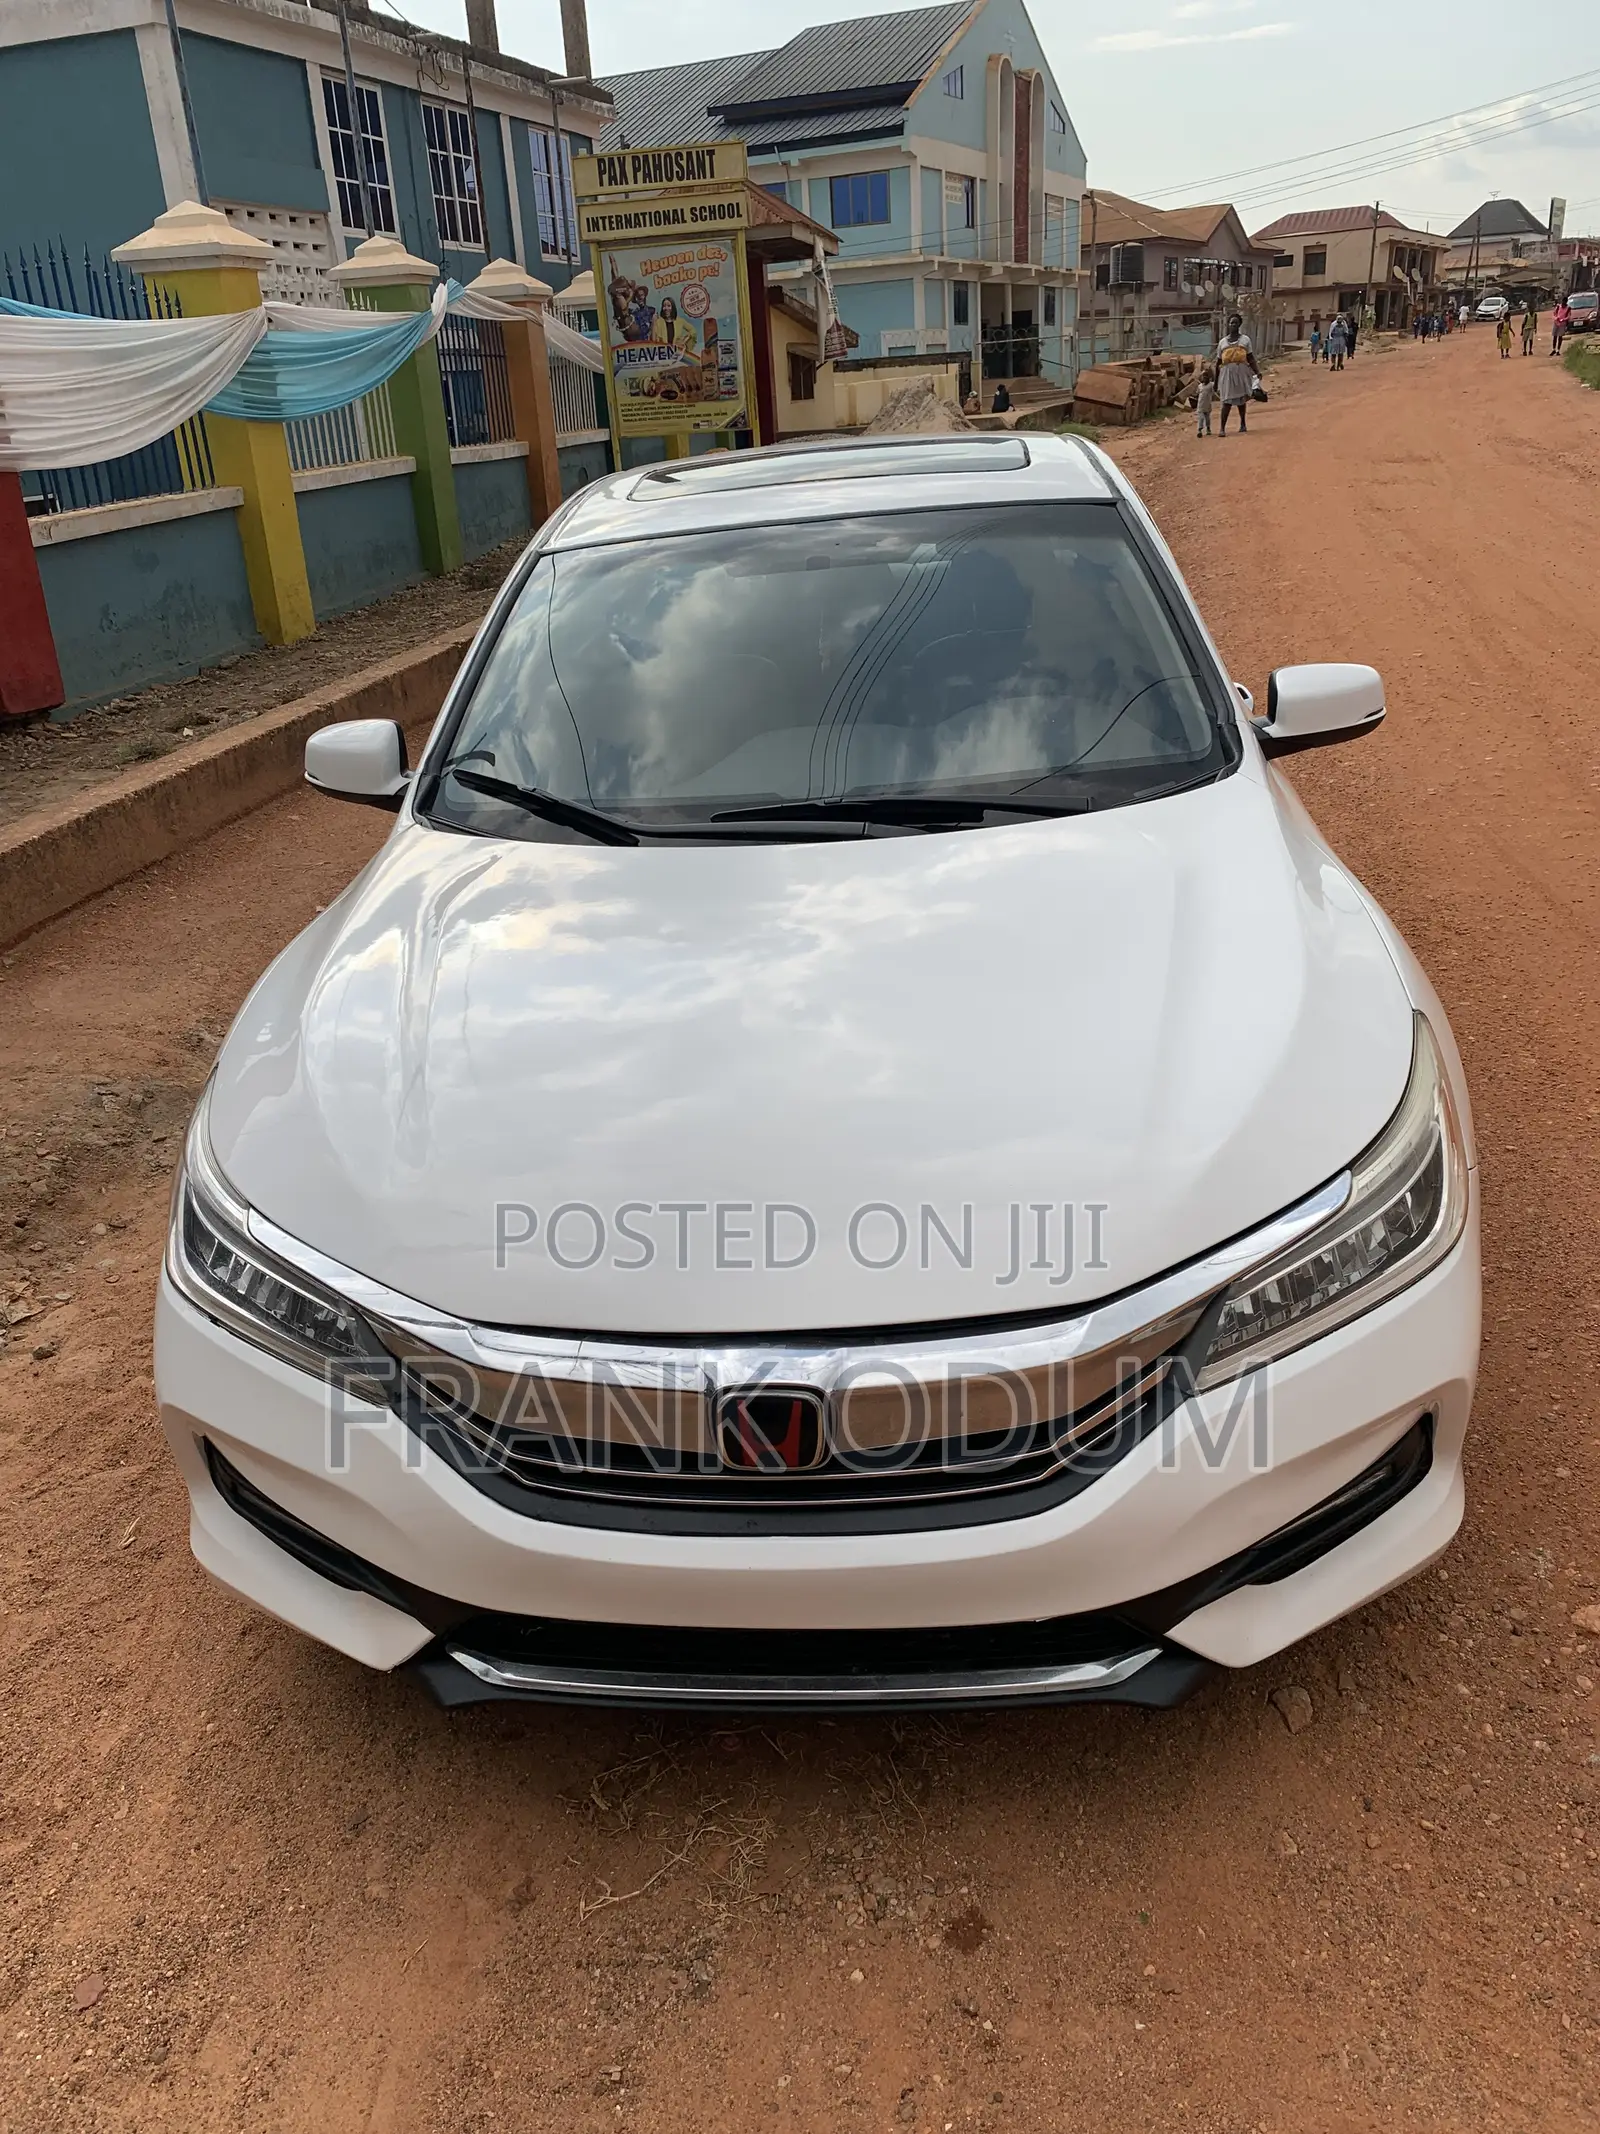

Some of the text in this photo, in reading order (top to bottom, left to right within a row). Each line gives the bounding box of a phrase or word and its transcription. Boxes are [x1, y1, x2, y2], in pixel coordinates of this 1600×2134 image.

[597, 149, 716, 187] PAX PAHOSANT
[586, 202, 742, 233] INTERNATIONAL SCHOOL
[640, 250, 694, 277] Heaven
[654, 266, 696, 289] baako
[616, 345, 677, 363] HEAVEN
